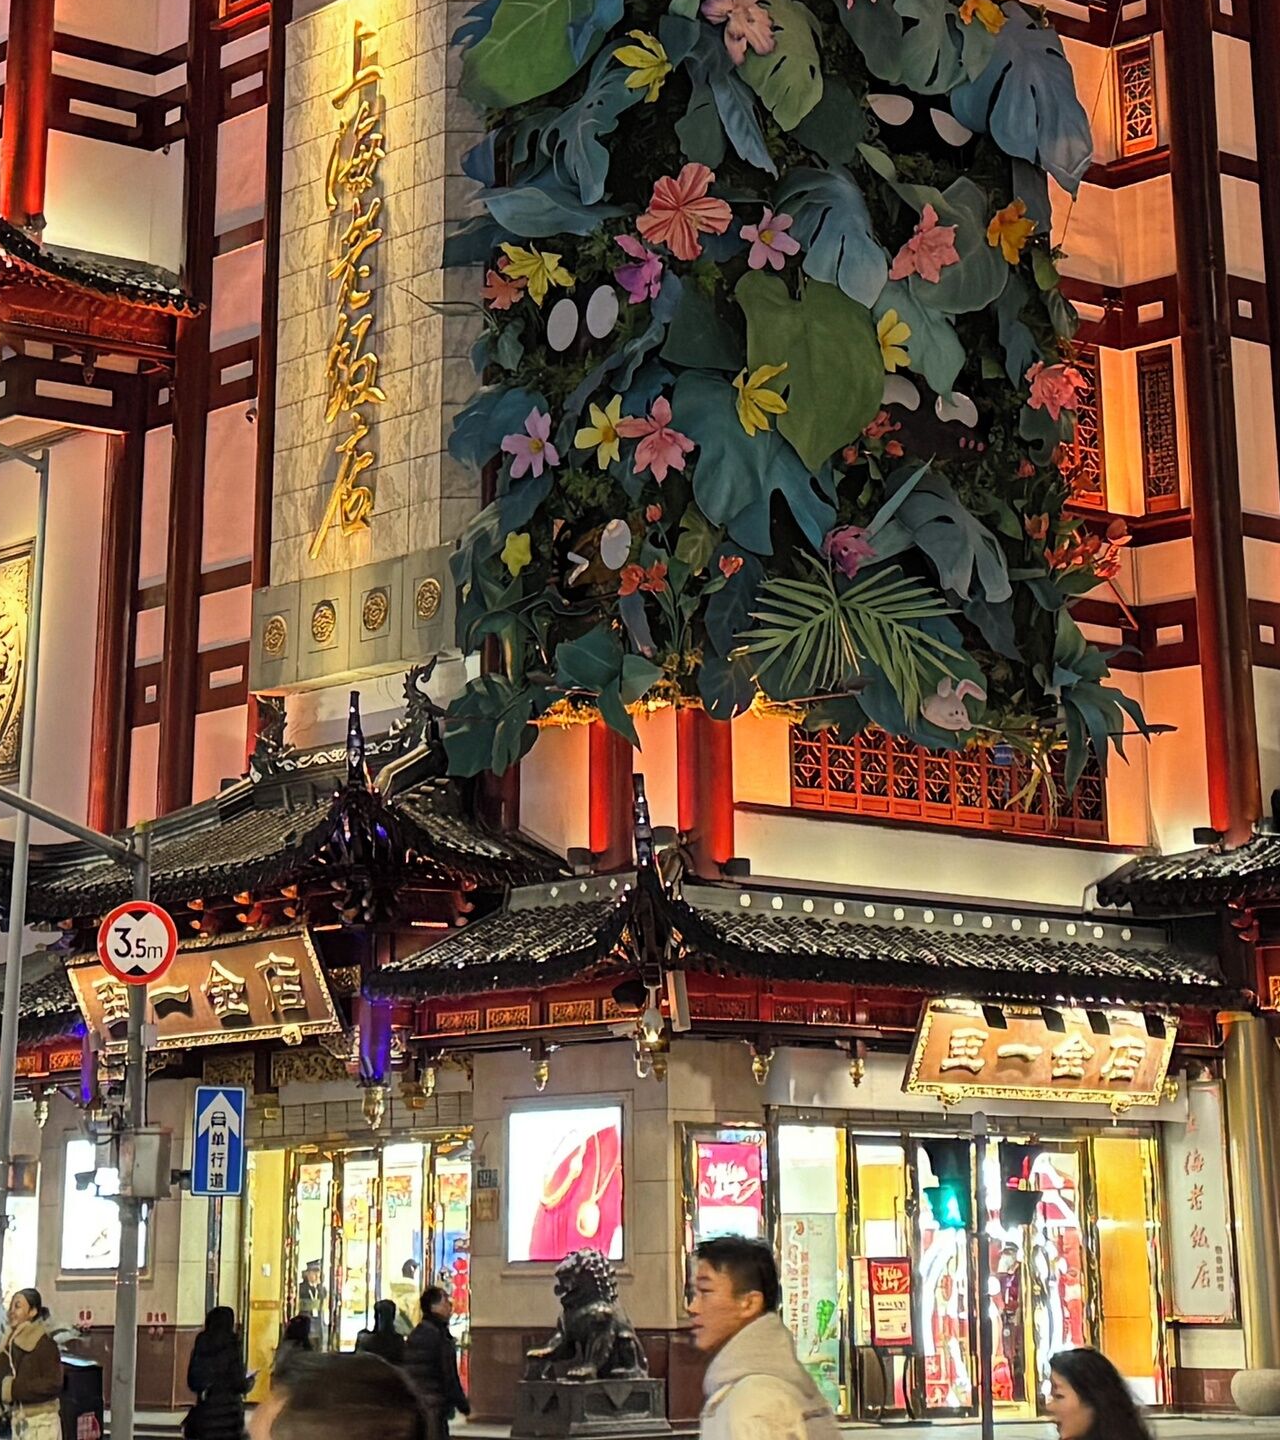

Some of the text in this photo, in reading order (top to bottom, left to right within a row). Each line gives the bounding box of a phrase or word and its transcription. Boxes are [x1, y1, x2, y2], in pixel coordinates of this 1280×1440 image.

[114, 927, 163, 959] 3.5m
[210, 1131, 225, 1188] 单行道
